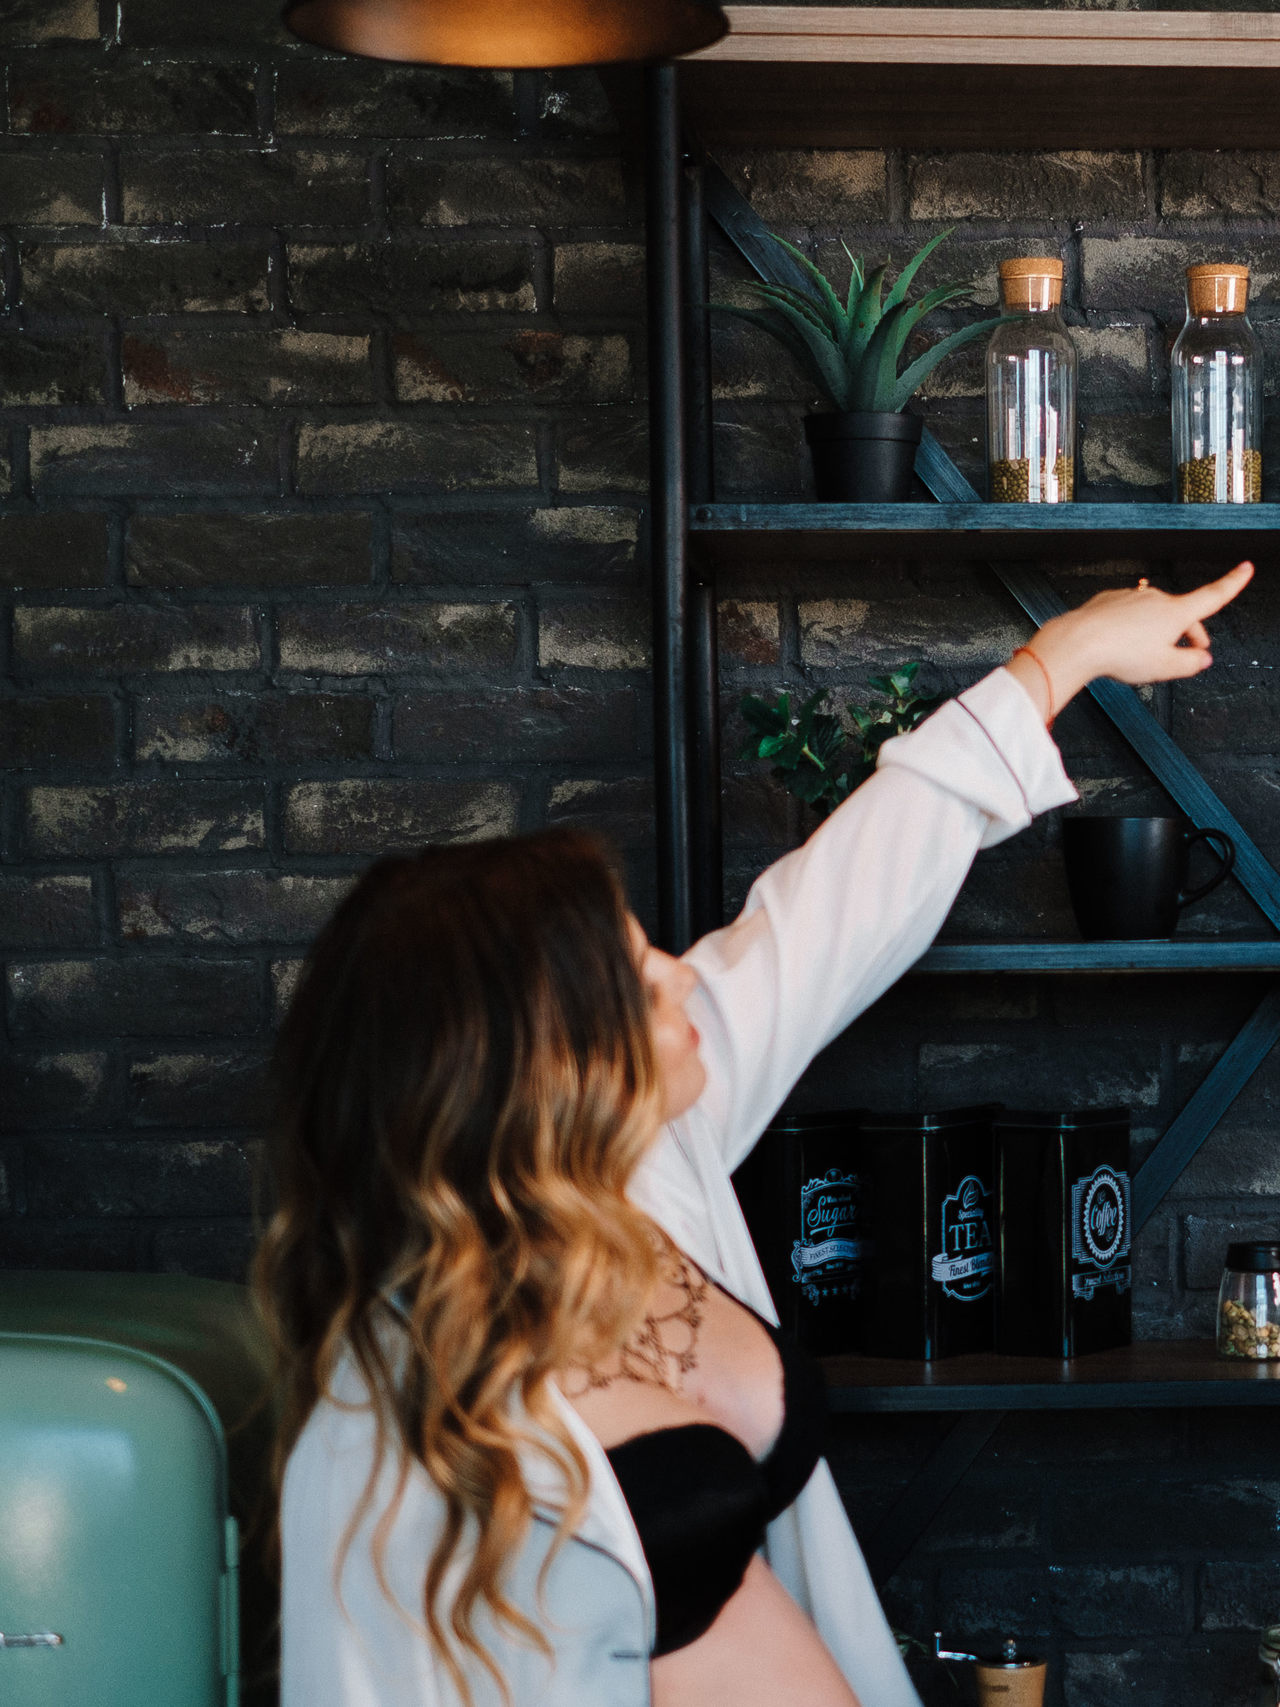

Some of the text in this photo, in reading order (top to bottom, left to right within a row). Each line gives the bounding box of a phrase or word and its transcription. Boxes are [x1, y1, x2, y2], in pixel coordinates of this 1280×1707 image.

[807, 1195, 856, 1238] Sugar
[1091, 1201, 1117, 1236] Coffee
[949, 1219, 992, 1251] TEA
[949, 1263, 969, 1276] Finest
